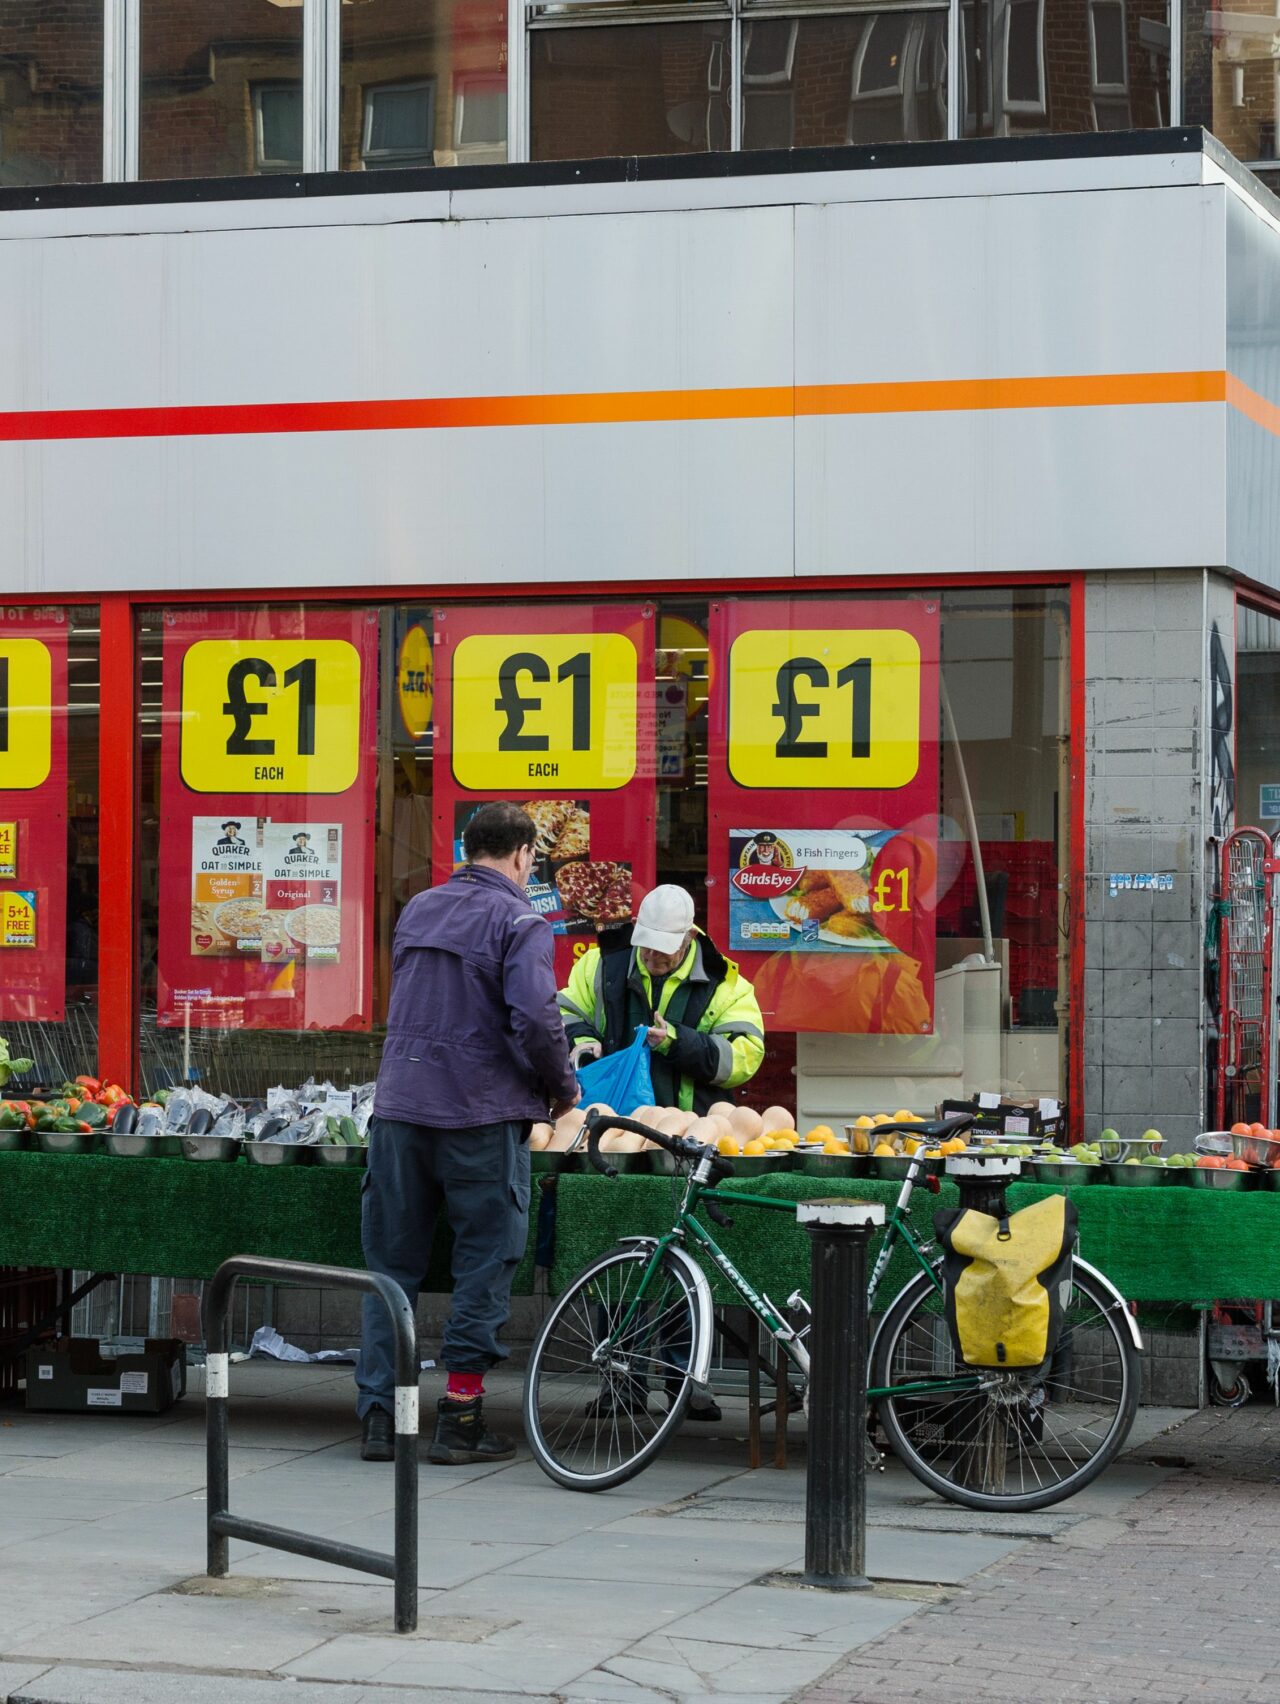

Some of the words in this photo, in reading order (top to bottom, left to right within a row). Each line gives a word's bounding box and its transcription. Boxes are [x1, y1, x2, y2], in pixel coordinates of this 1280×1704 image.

[222, 658, 317, 756] £1
[494, 652, 591, 752] £1
[771, 657, 872, 759] £1
[254, 766, 284, 780] EACH
[528, 763, 559, 777] EACH
[212, 846, 250, 857] QUAKER
[796, 849, 803, 857] 8
[804, 849, 823, 858] Fish
[824, 849, 859, 859] Fingers
[284, 854, 319, 865] QUAKER
[201, 861, 219, 870] OAT
[228, 861, 262, 871] SIMPLE
[274, 869, 291, 878] OAT
[299, 869, 330, 878] SIMPLE
[209, 878, 237, 886] Golden
[740, 872, 793, 888] BirdsEye
[211, 887, 235, 897] Syrup
[530, 884, 551, 894] TOWN
[873, 867, 911, 913] £1
[277, 890, 311, 900] Original
[8, 905, 30, 918] 5+1
[6, 920, 30, 931] FREE
[716, 1254, 772, 1318] Hewitt
